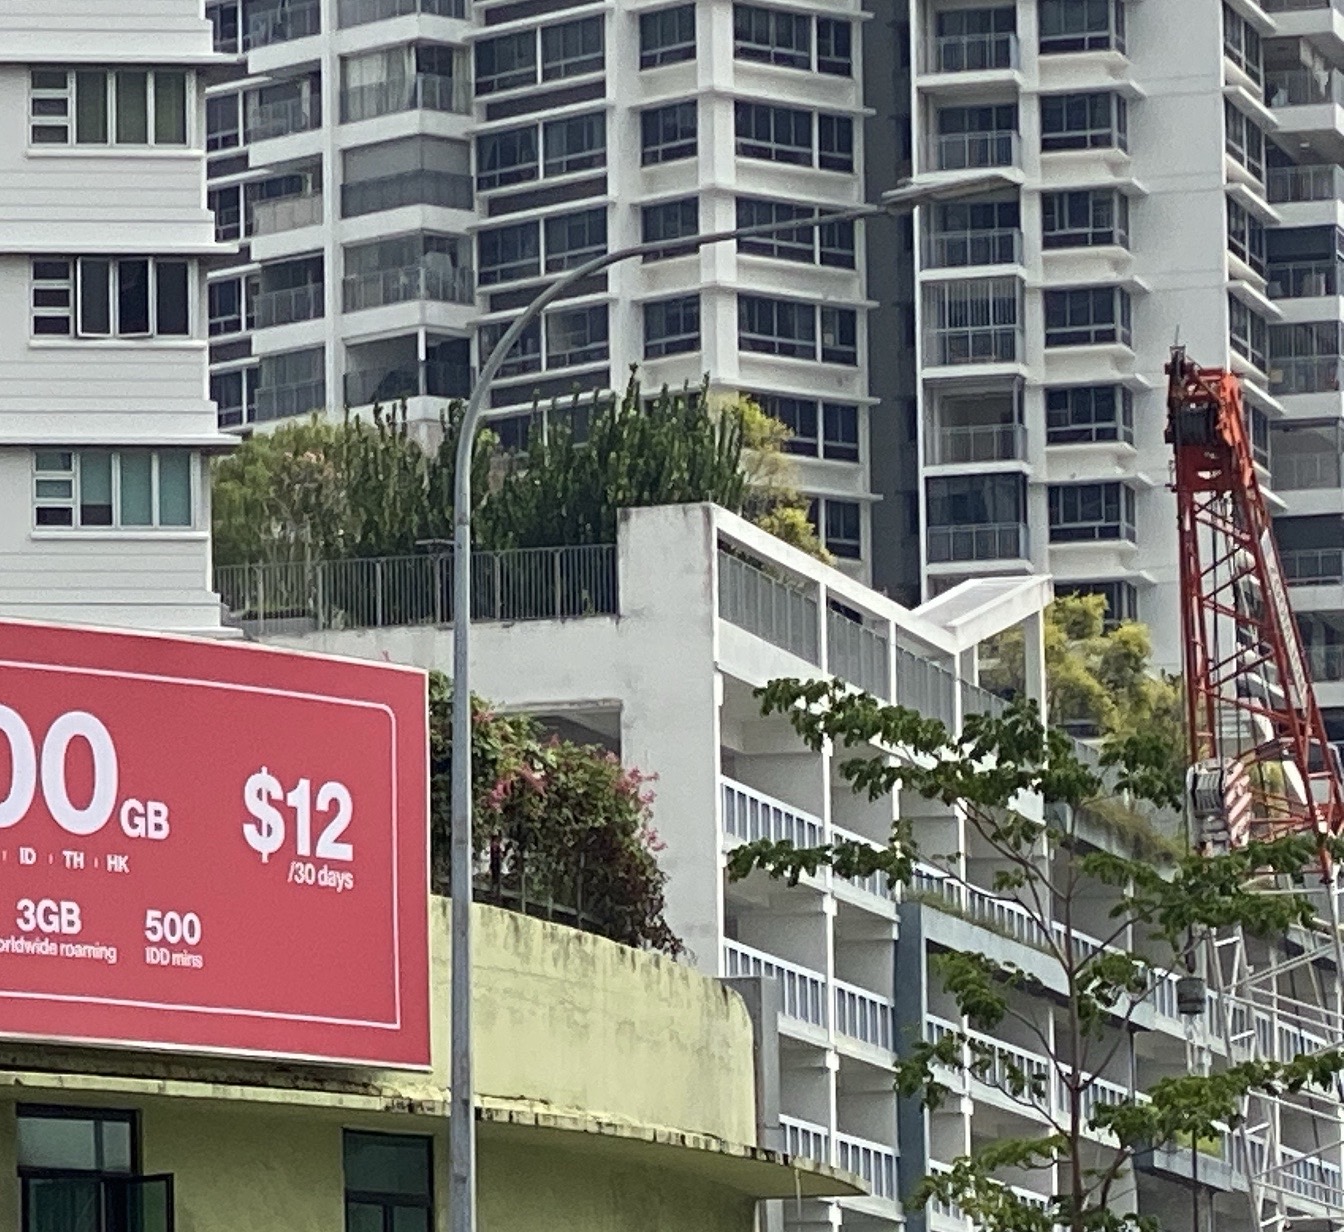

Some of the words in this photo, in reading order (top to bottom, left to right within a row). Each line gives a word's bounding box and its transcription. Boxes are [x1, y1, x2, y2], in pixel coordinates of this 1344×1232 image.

[242, 766, 355, 863] $12
[19, 847, 37, 866] ID
[63, 849, 85, 870] TH
[107, 853, 130, 874] HK
[287, 860, 316, 886] /30
[316, 864, 354, 891] days
[15, 898, 82, 936] 3GB
[144, 908, 202, 946] 500
[57, 939, 118, 965] roaming
[144, 946, 169, 967] IDD
[171, 948, 204, 969] mins
